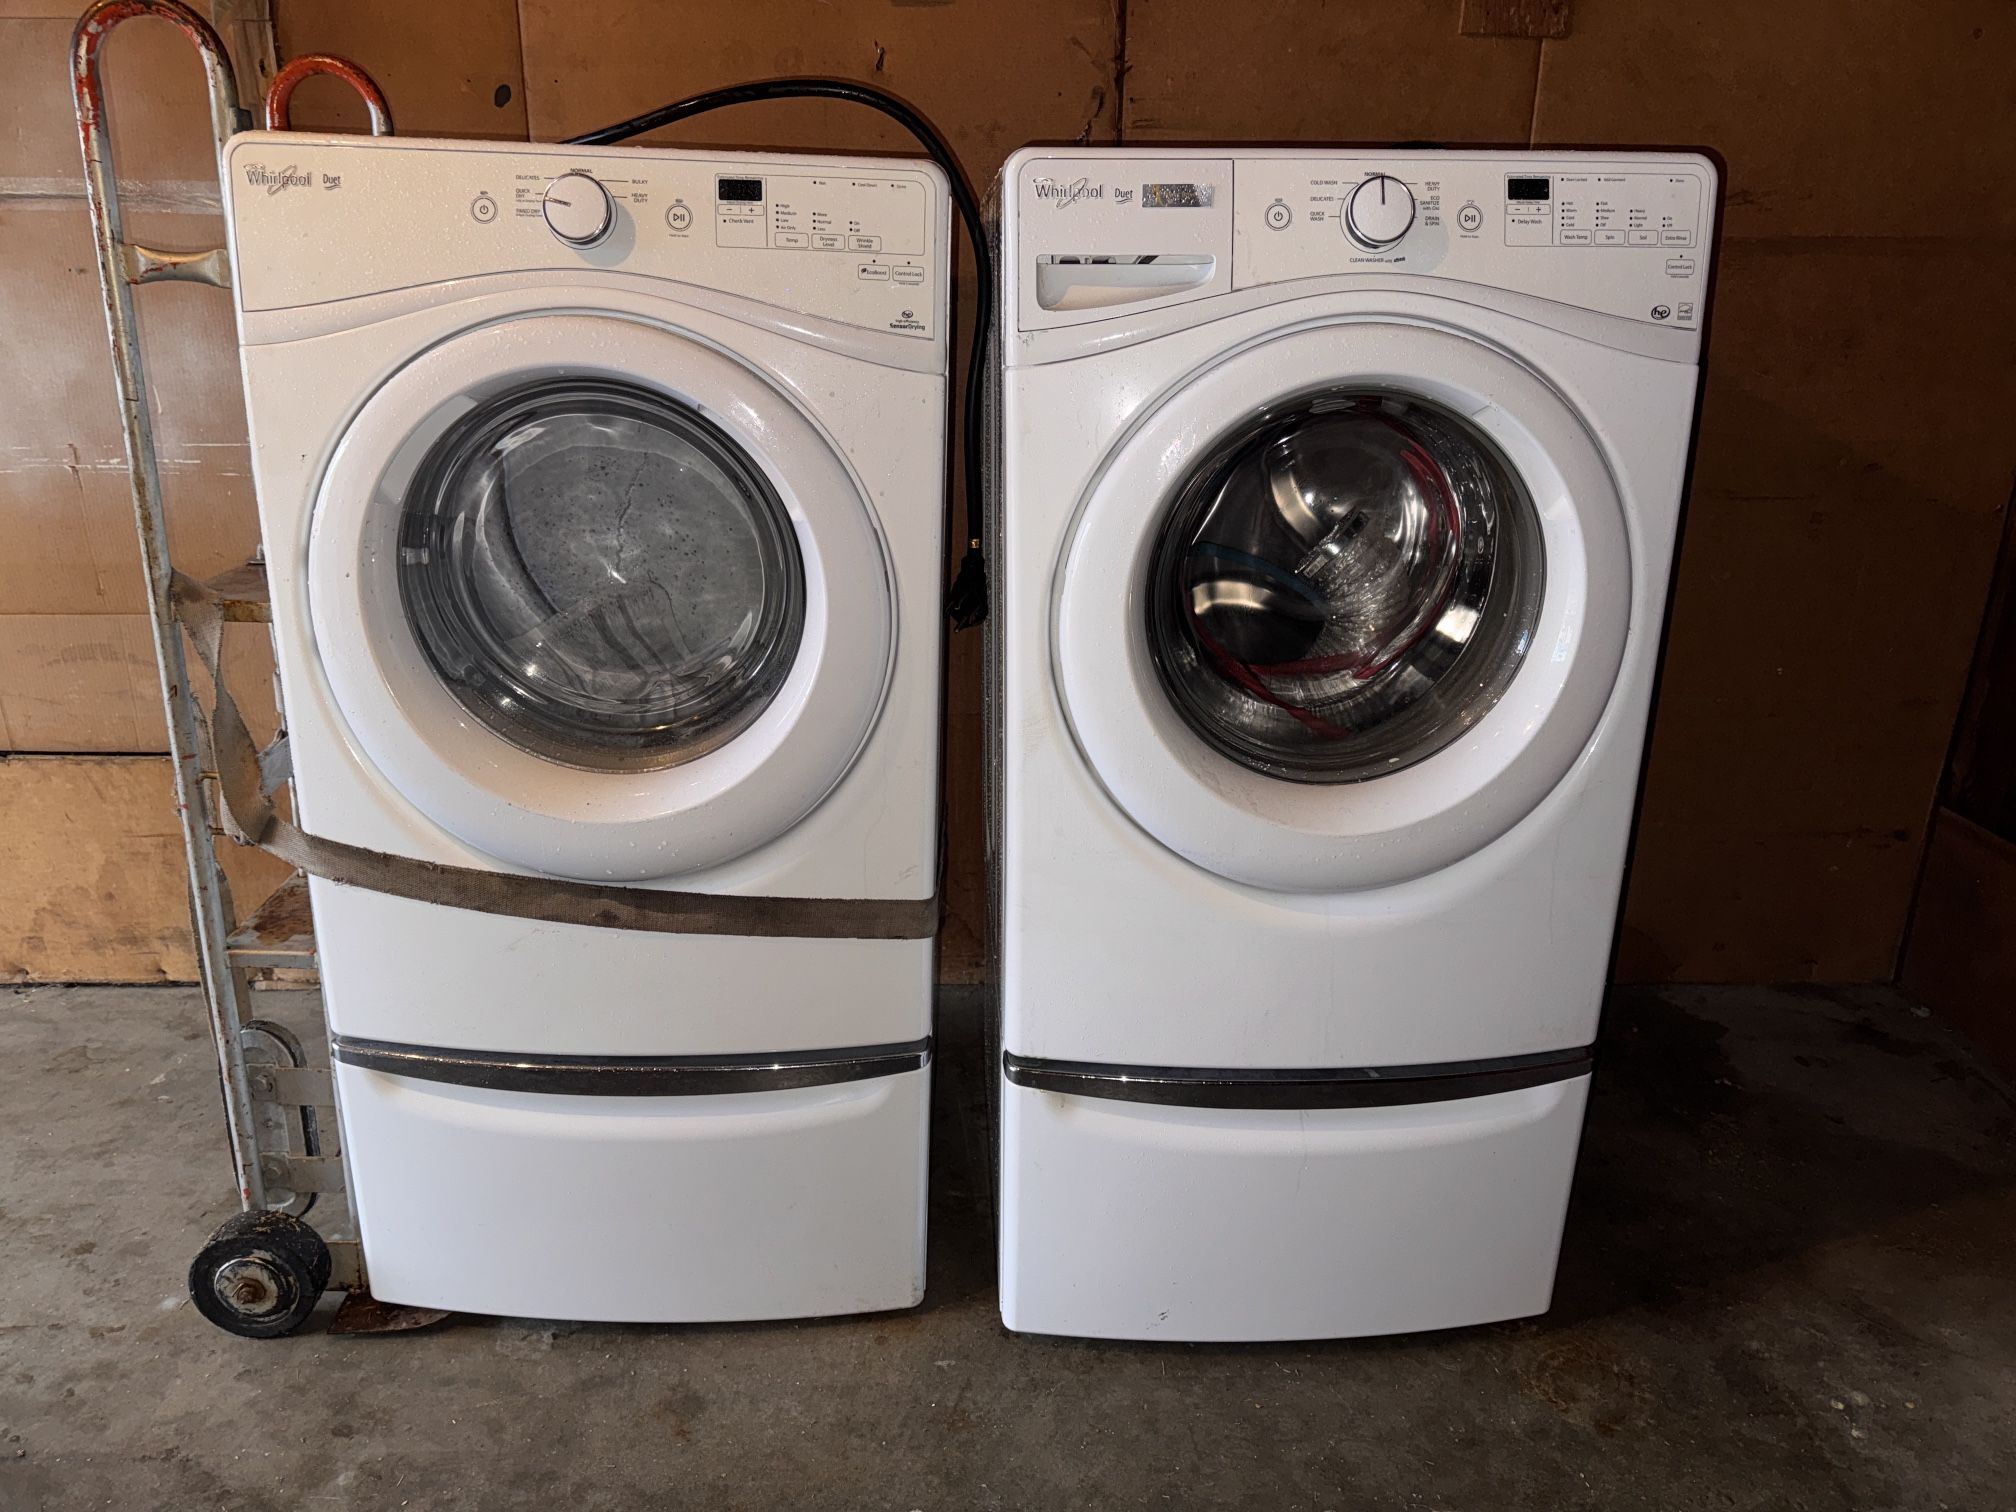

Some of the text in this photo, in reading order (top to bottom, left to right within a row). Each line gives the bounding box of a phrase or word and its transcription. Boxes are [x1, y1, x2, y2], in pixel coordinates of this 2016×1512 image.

[246, 168, 312, 191] Whirlpool
[322, 174, 341, 185] Duet
[1035, 181, 1104, 204] Whirlpool
[1114, 187, 1133, 198] Duet
[889, 323, 926, 331] SensorDrying
